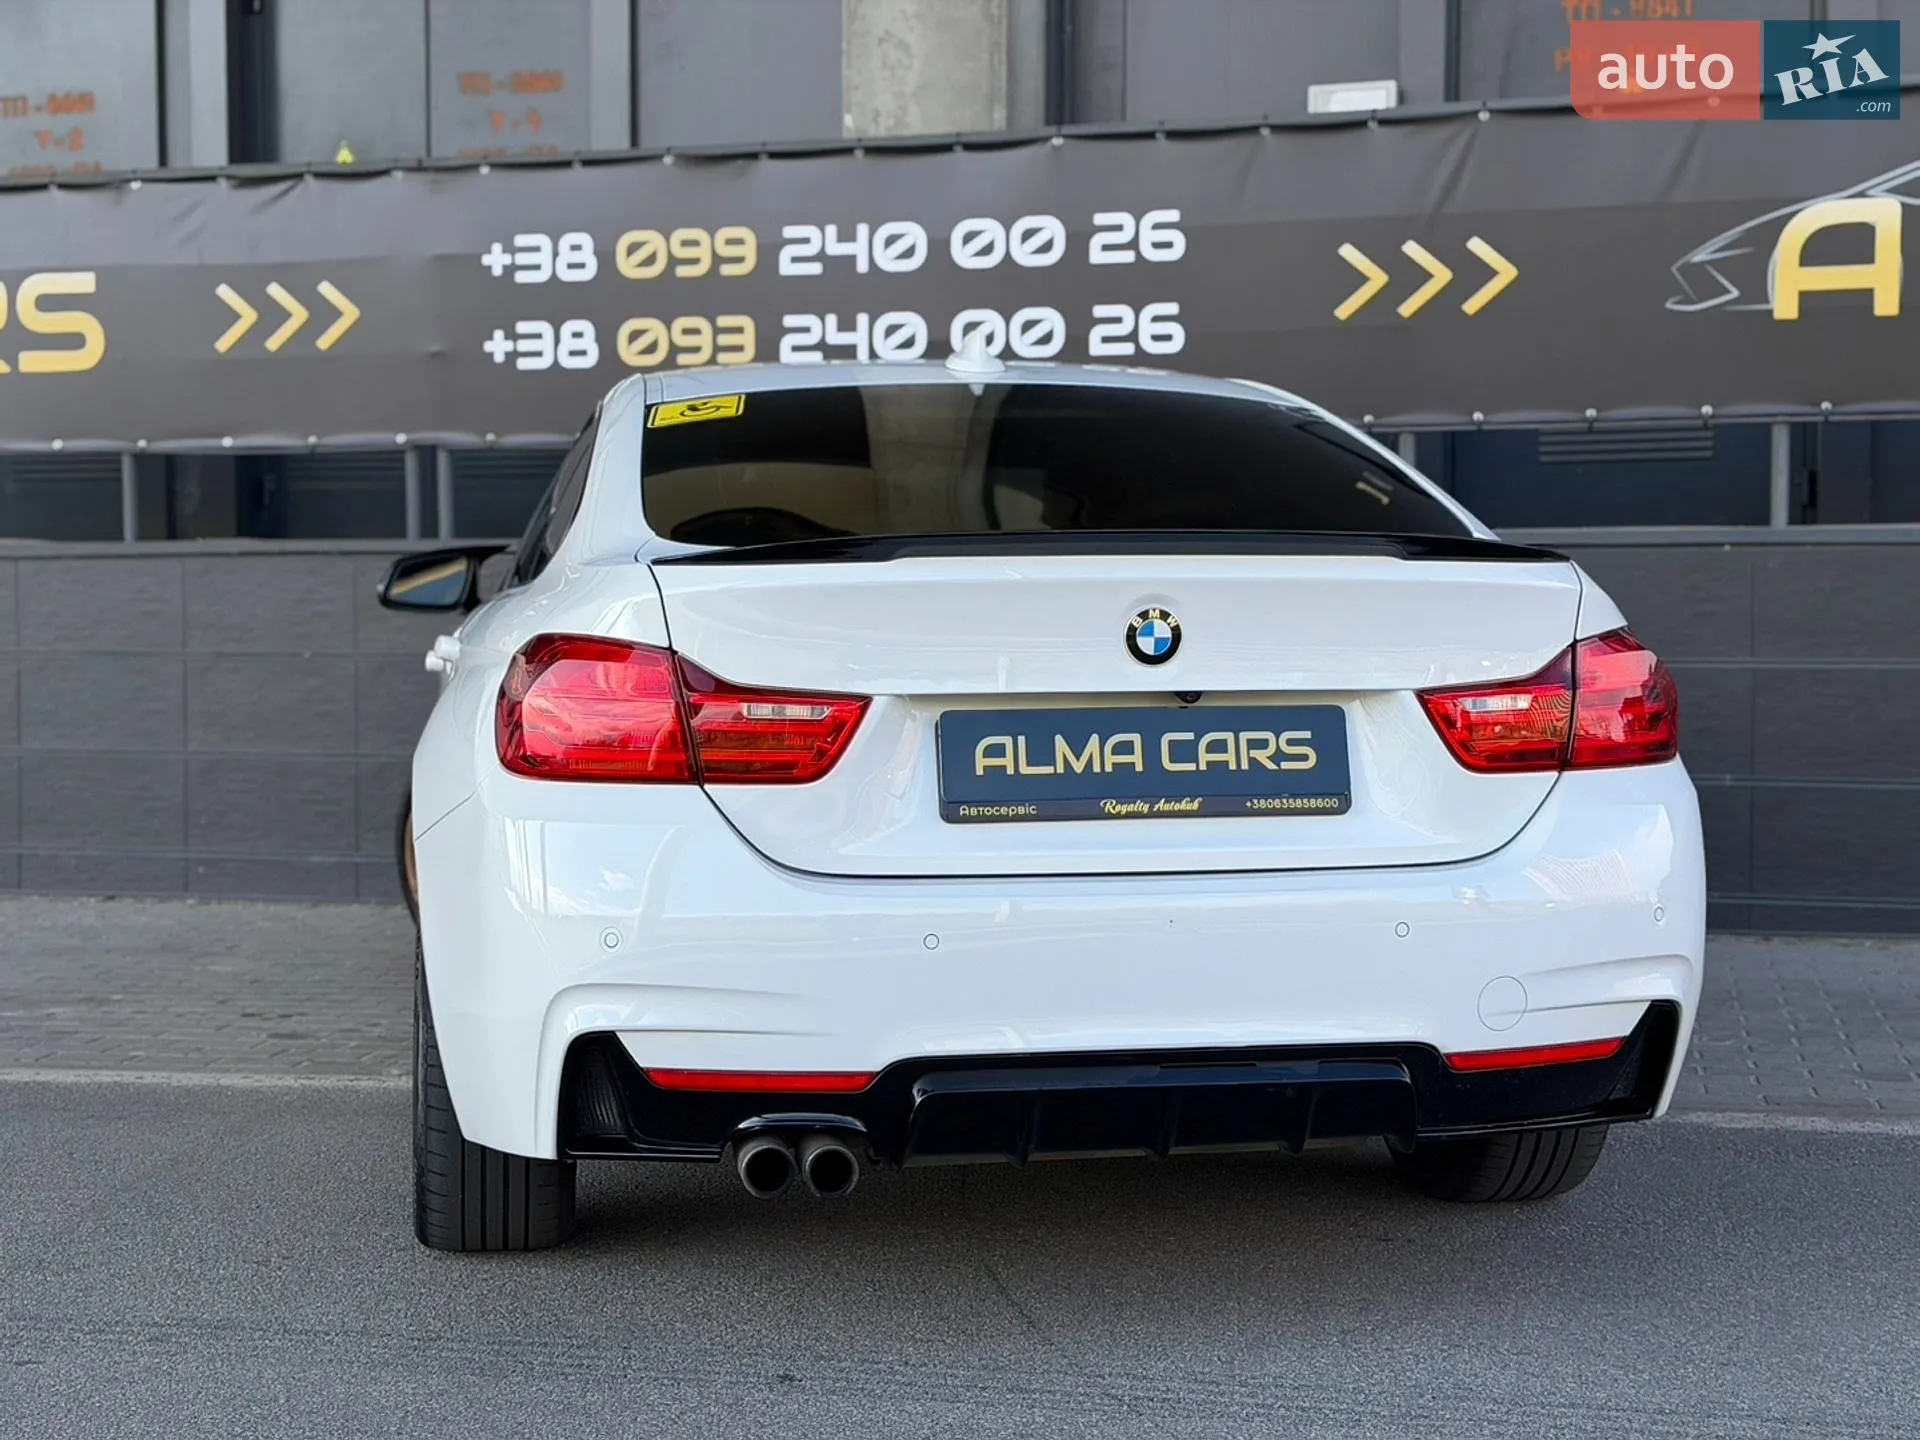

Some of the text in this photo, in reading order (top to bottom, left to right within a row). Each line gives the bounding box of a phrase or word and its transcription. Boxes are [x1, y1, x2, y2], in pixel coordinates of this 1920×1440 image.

[481, 209, 1187, 283] +38 099 240 00 26
[0, 271, 106, 374] S
[483, 302, 1187, 371] +38 093 240 00 26
[1131, 607, 1179, 628] BMW
[974, 730, 1318, 776] ALMA CARS
[959, 802, 1038, 817] Автосервіс
[1100, 798, 1150, 815] Royalty
